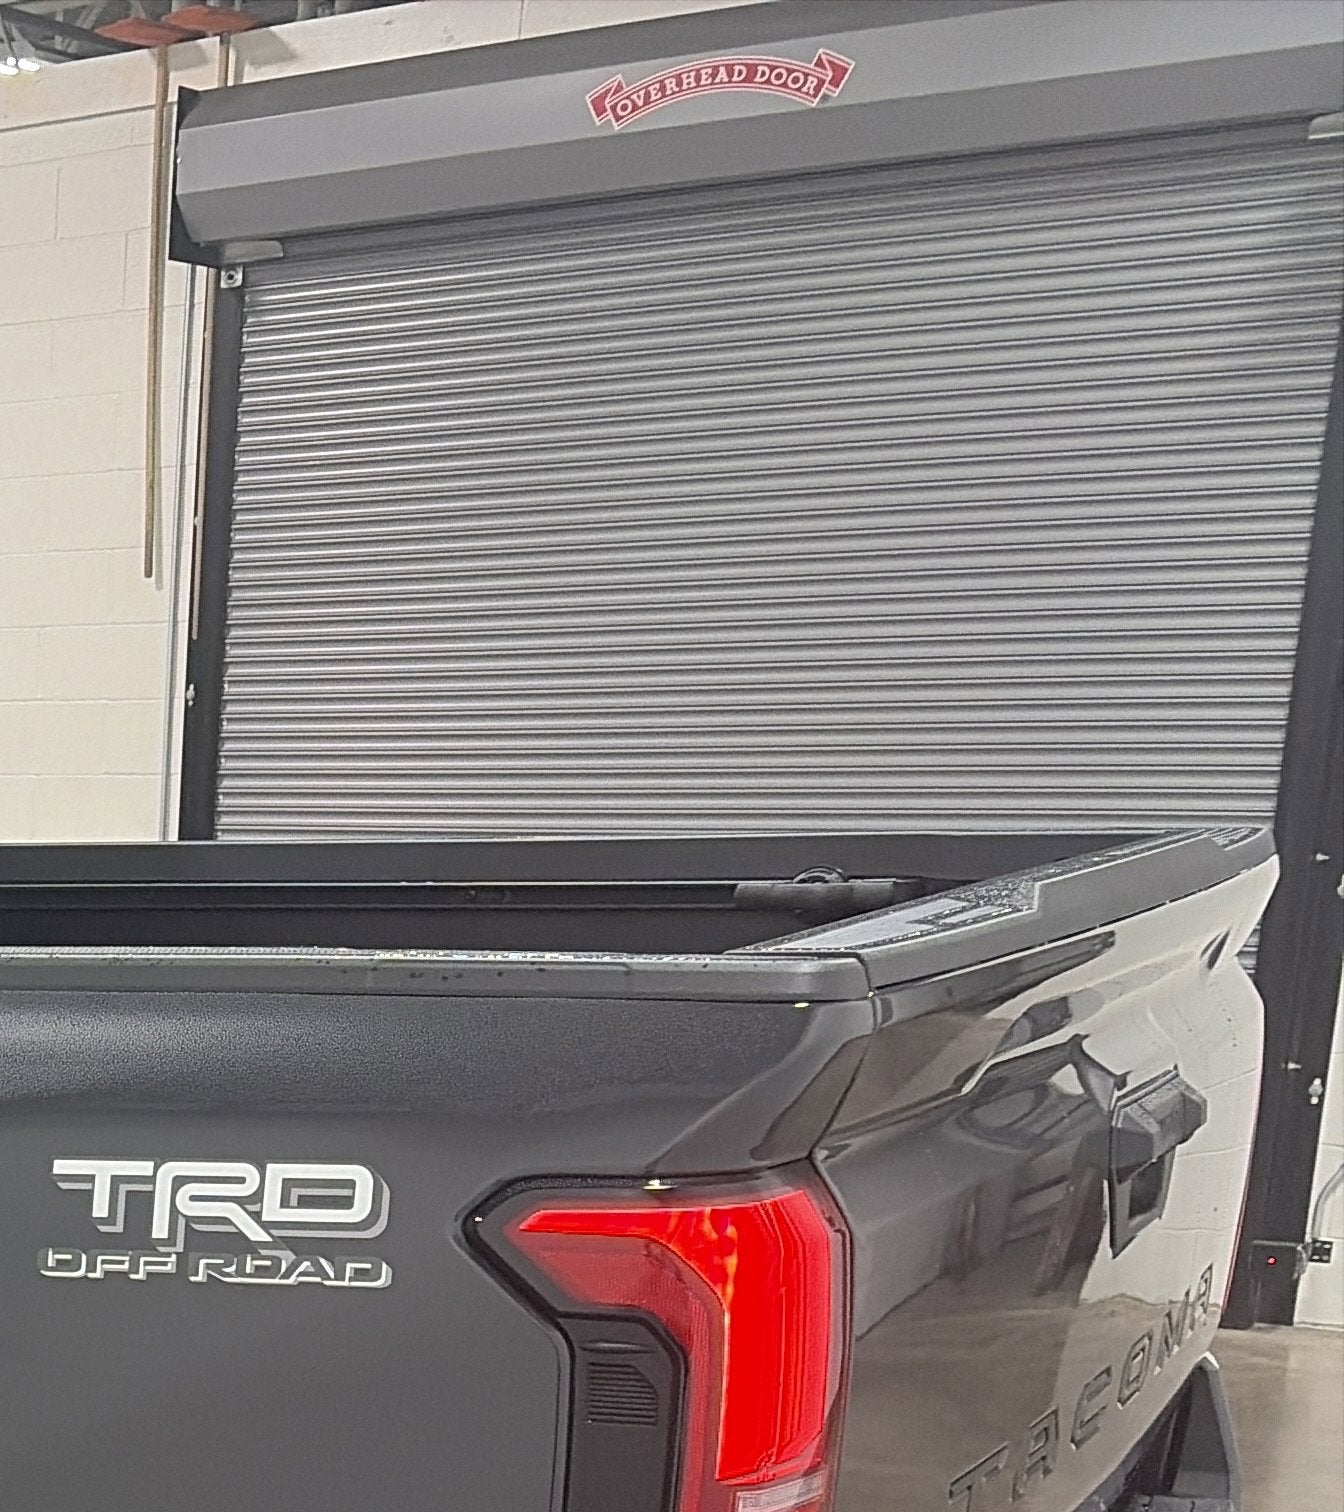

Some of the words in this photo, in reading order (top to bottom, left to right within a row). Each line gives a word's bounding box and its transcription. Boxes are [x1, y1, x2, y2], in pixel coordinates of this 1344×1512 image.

[615, 64, 748, 117] OVERHEAD
[754, 65, 819, 95] DOOR
[51, 1158, 391, 1253] TRD
[38, 1248, 176, 1281] OFF
[187, 1250, 392, 1289] ROAD
